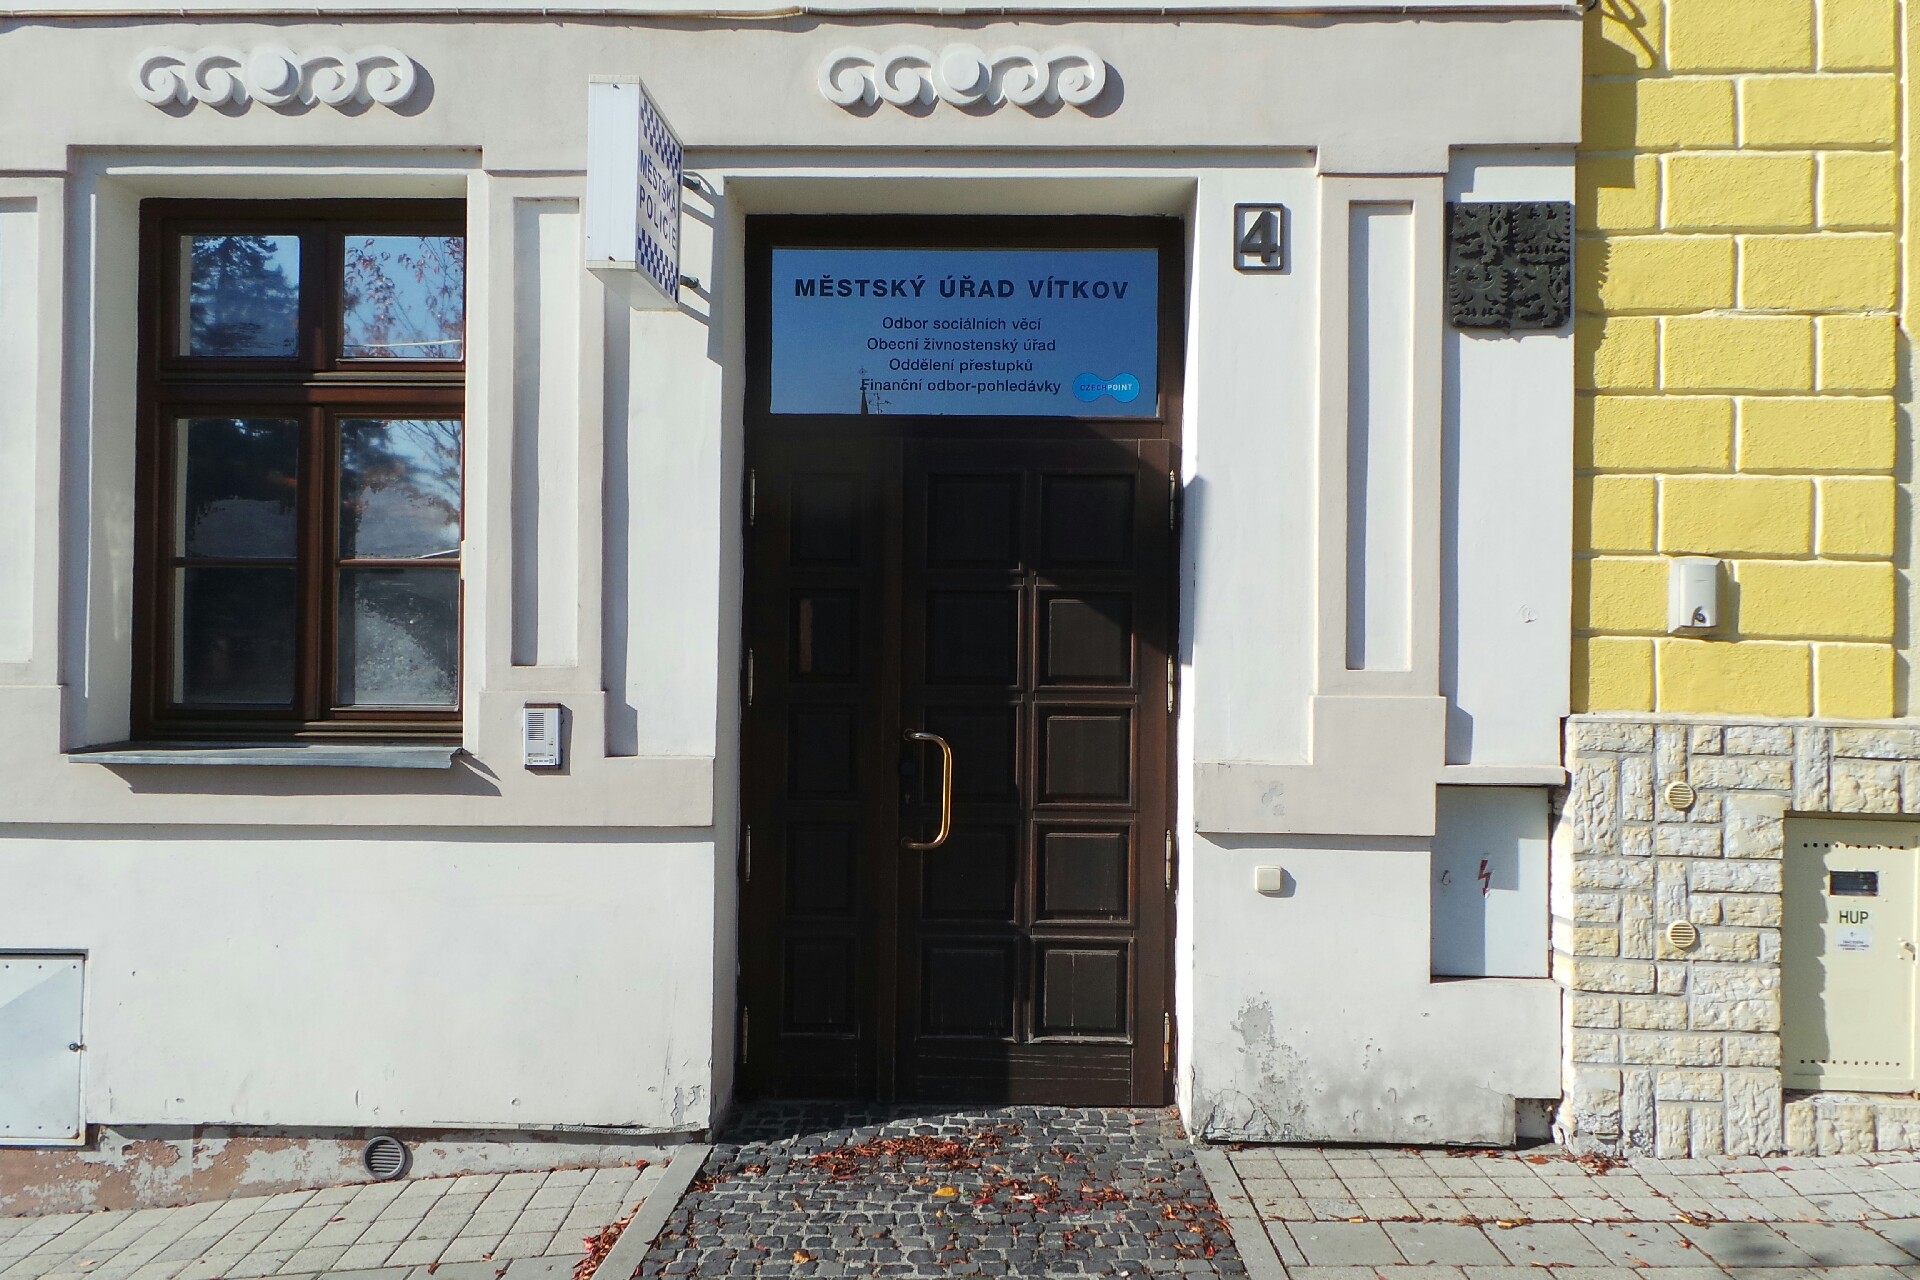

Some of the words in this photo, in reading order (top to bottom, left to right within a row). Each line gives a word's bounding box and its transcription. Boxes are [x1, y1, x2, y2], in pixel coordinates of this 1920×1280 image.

[640, 149, 676, 219] MĚSTSKÁ
[639, 184, 676, 251] POLICIE
[1240, 210, 1277, 262] 4
[794, 275, 926, 298] MĚSTSKÝ
[939, 275, 1015, 299] ÚŘAD
[1028, 276, 1129, 299] VÍTKOV
[882, 316, 929, 330] Odbor
[932, 315, 1006, 331] sociálních
[1011, 317, 1042, 331] věcí
[866, 337, 919, 351] Obecní
[922, 337, 1019, 354] živnostenský
[1023, 337, 1056, 352] úřad
[889, 357, 955, 371] Oddělení
[959, 358, 1033, 374] přestupků
[861, 378, 923, 392] Finanční
[927, 379, 1062, 395] odbor-pohledávky
[1839, 910, 1869, 924] HUP
